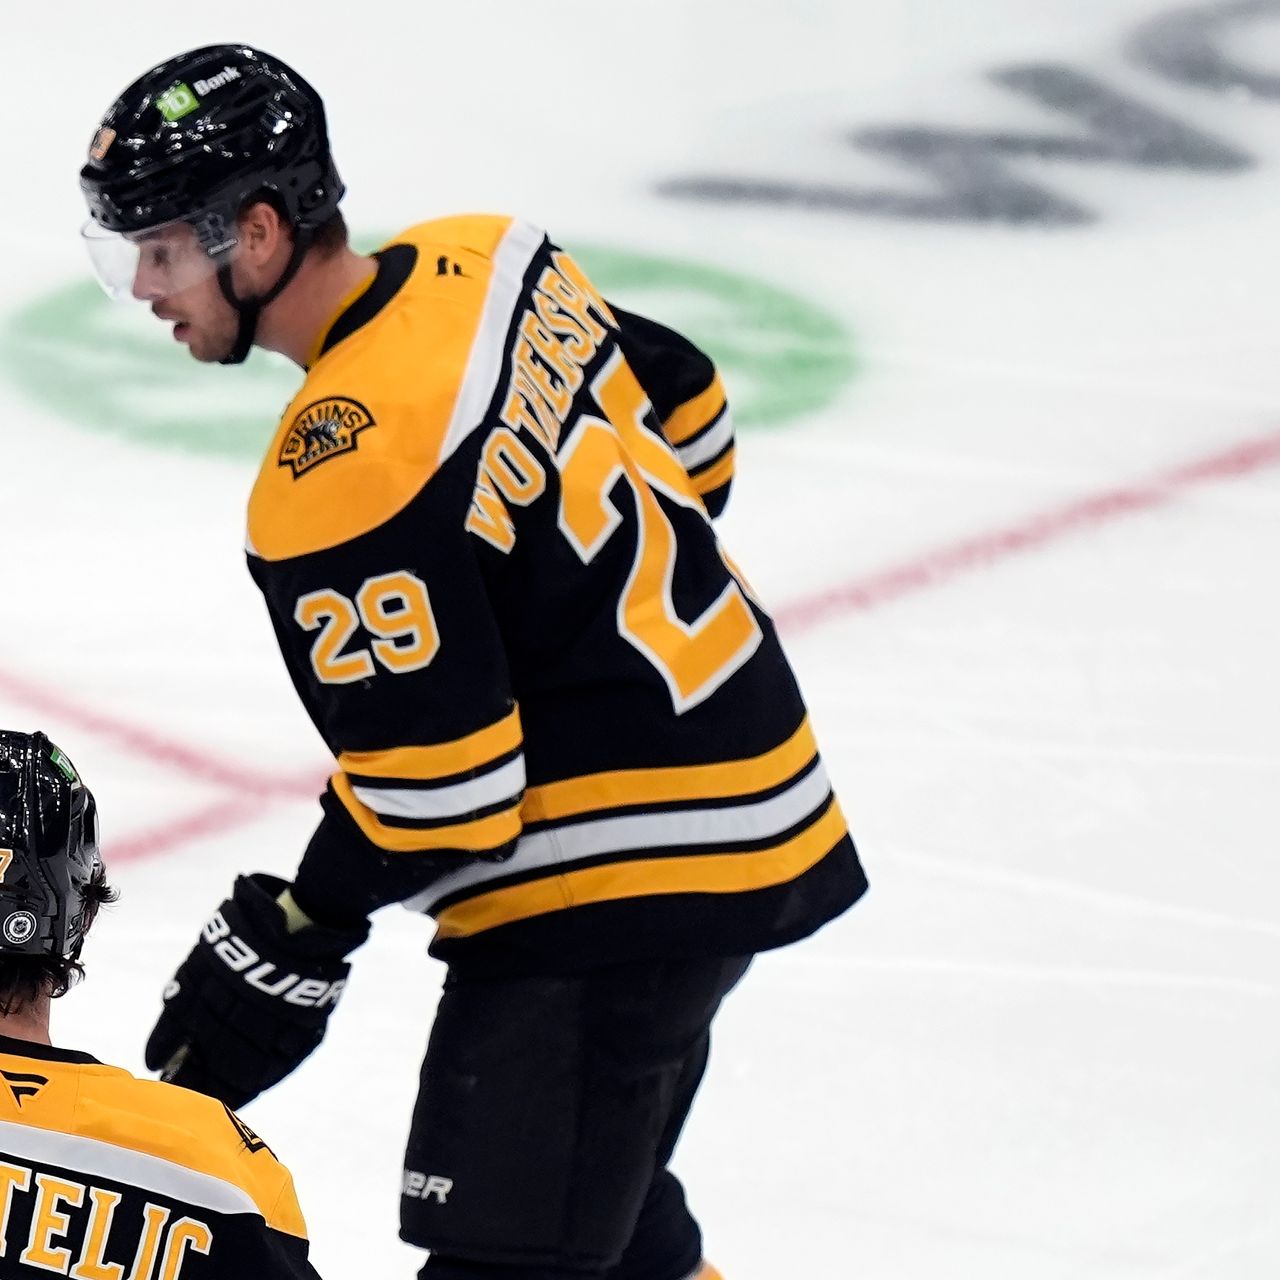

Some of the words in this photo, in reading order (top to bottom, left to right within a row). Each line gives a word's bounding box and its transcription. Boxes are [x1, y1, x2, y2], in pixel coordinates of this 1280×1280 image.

[193, 66, 242, 97] Bank
[285, 404, 363, 455] BRUINS
[293, 567, 442, 687] 29
[202, 909, 348, 1009] BAUER
